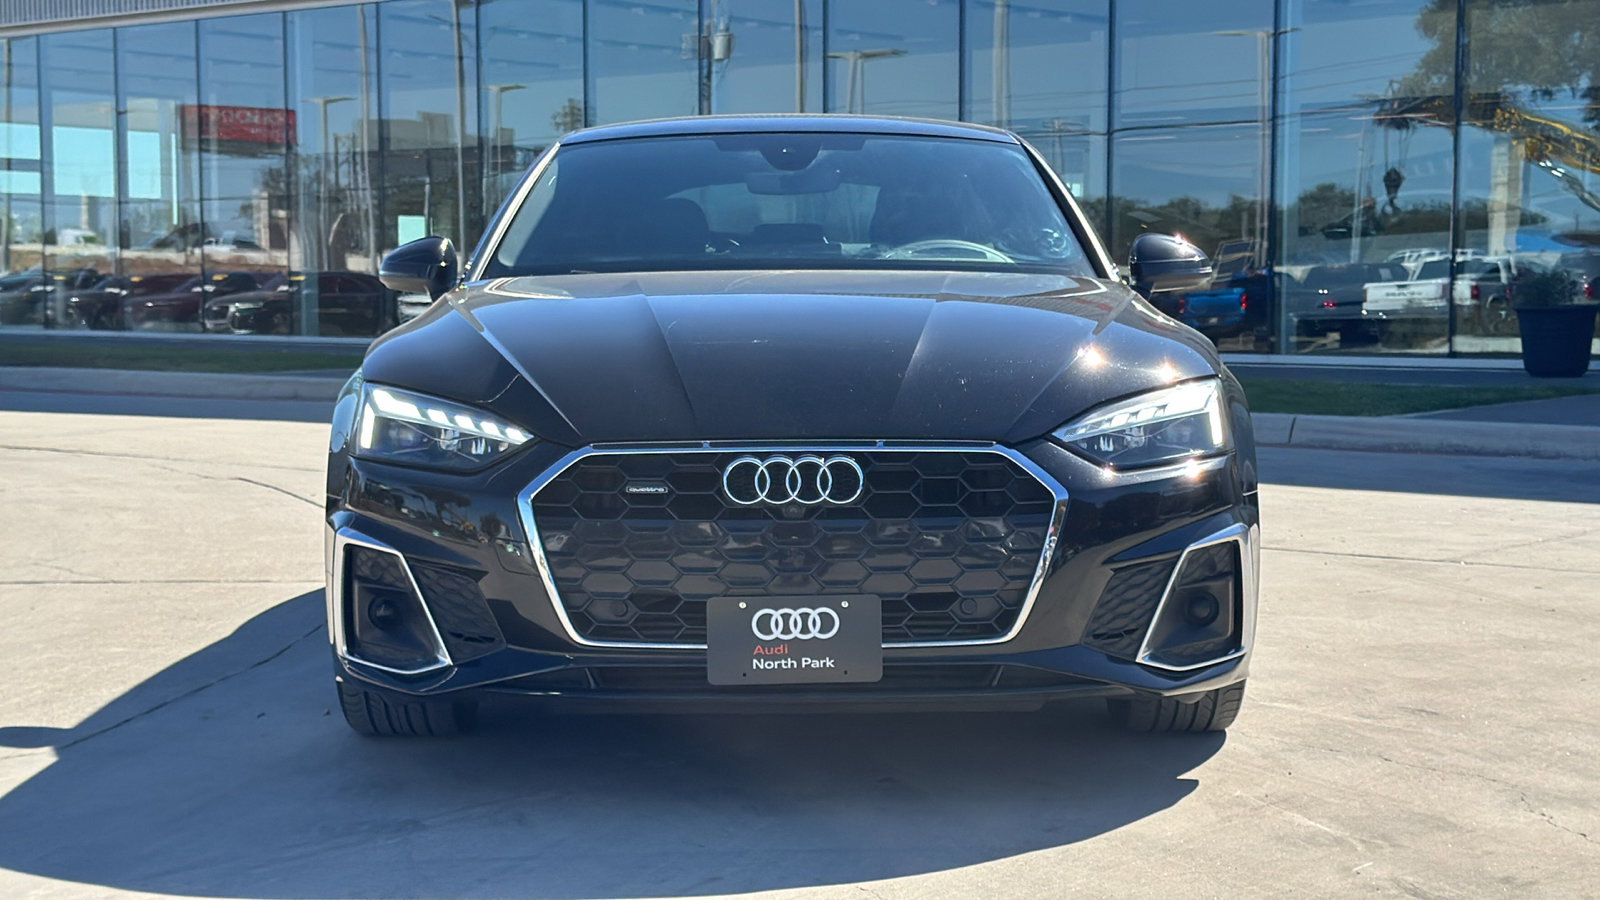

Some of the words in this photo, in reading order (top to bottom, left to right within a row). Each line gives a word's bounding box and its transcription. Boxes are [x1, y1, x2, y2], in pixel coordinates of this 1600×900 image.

[753, 643, 789, 656] Audi
[752, 657, 798, 670] North
[801, 656, 835, 669] Park
